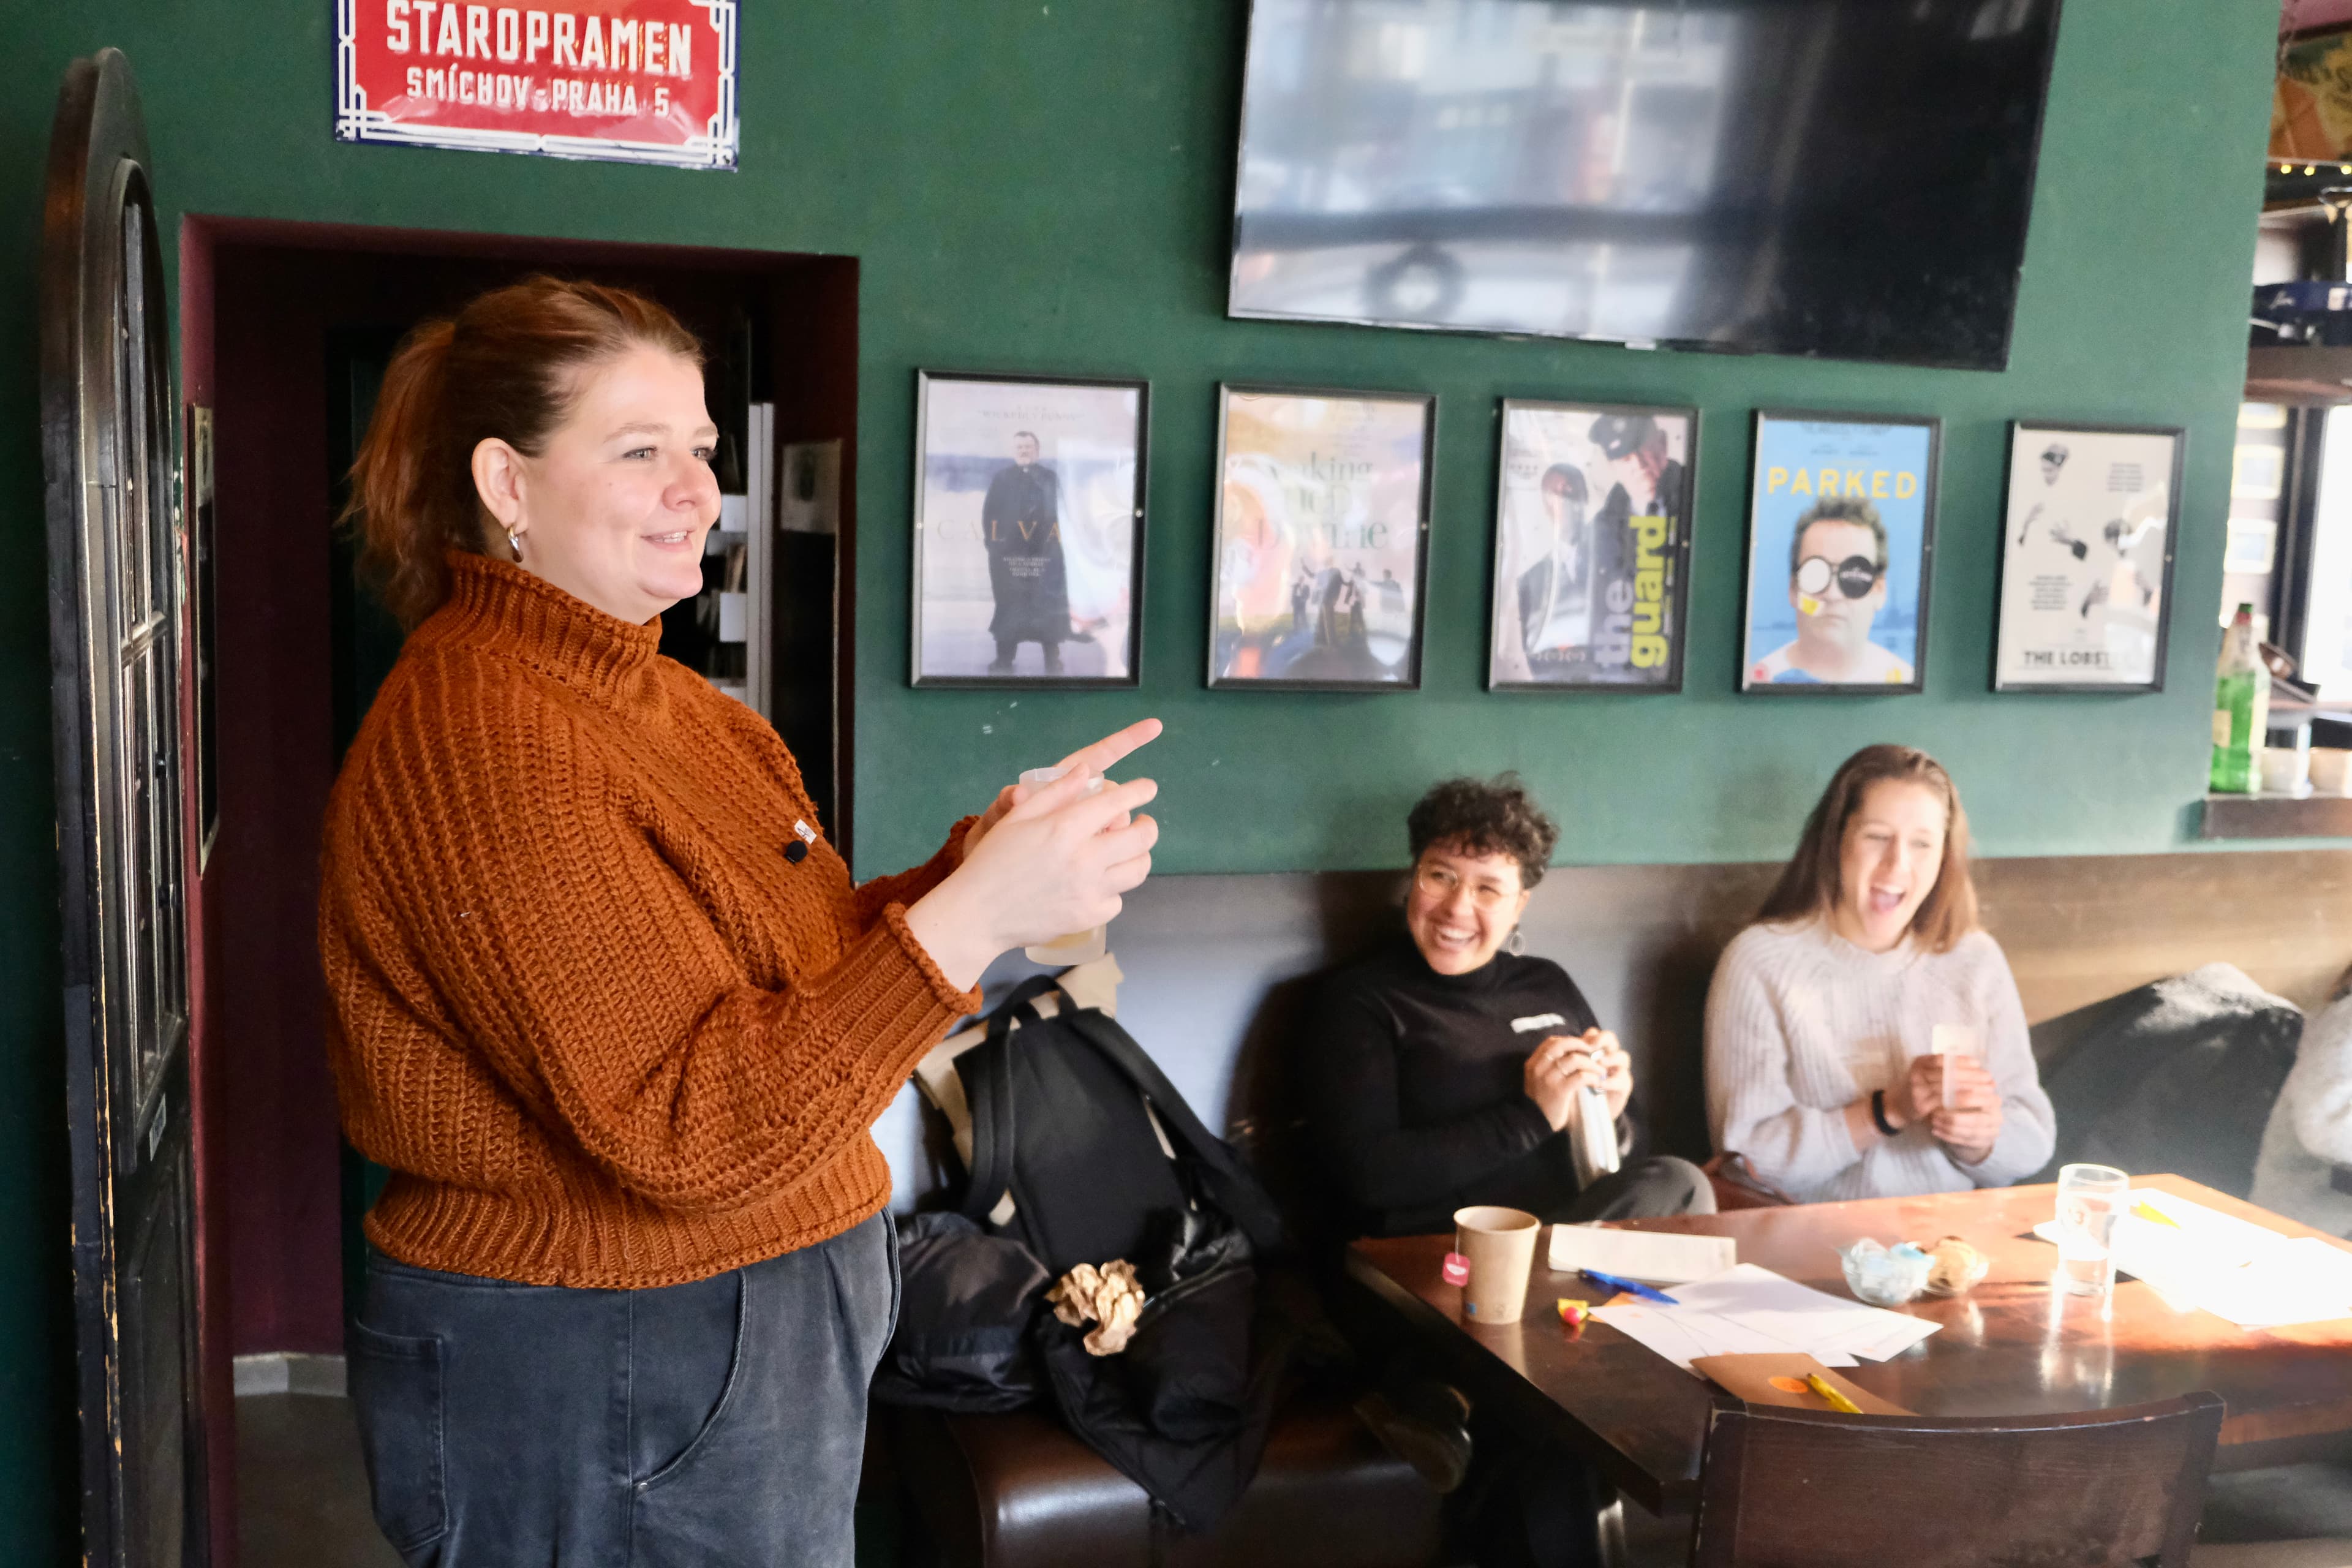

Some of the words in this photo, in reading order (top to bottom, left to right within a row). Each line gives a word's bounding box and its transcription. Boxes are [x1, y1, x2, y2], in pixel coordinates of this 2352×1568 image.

[387, 0, 692, 75] STAROPRAMEN
[654, 88, 670, 116] 5
[1768, 467, 1917, 500] PARKED
[1629, 515, 1669, 668] guard
[1593, 579, 1634, 667] the
[2024, 651, 2054, 665] THE
